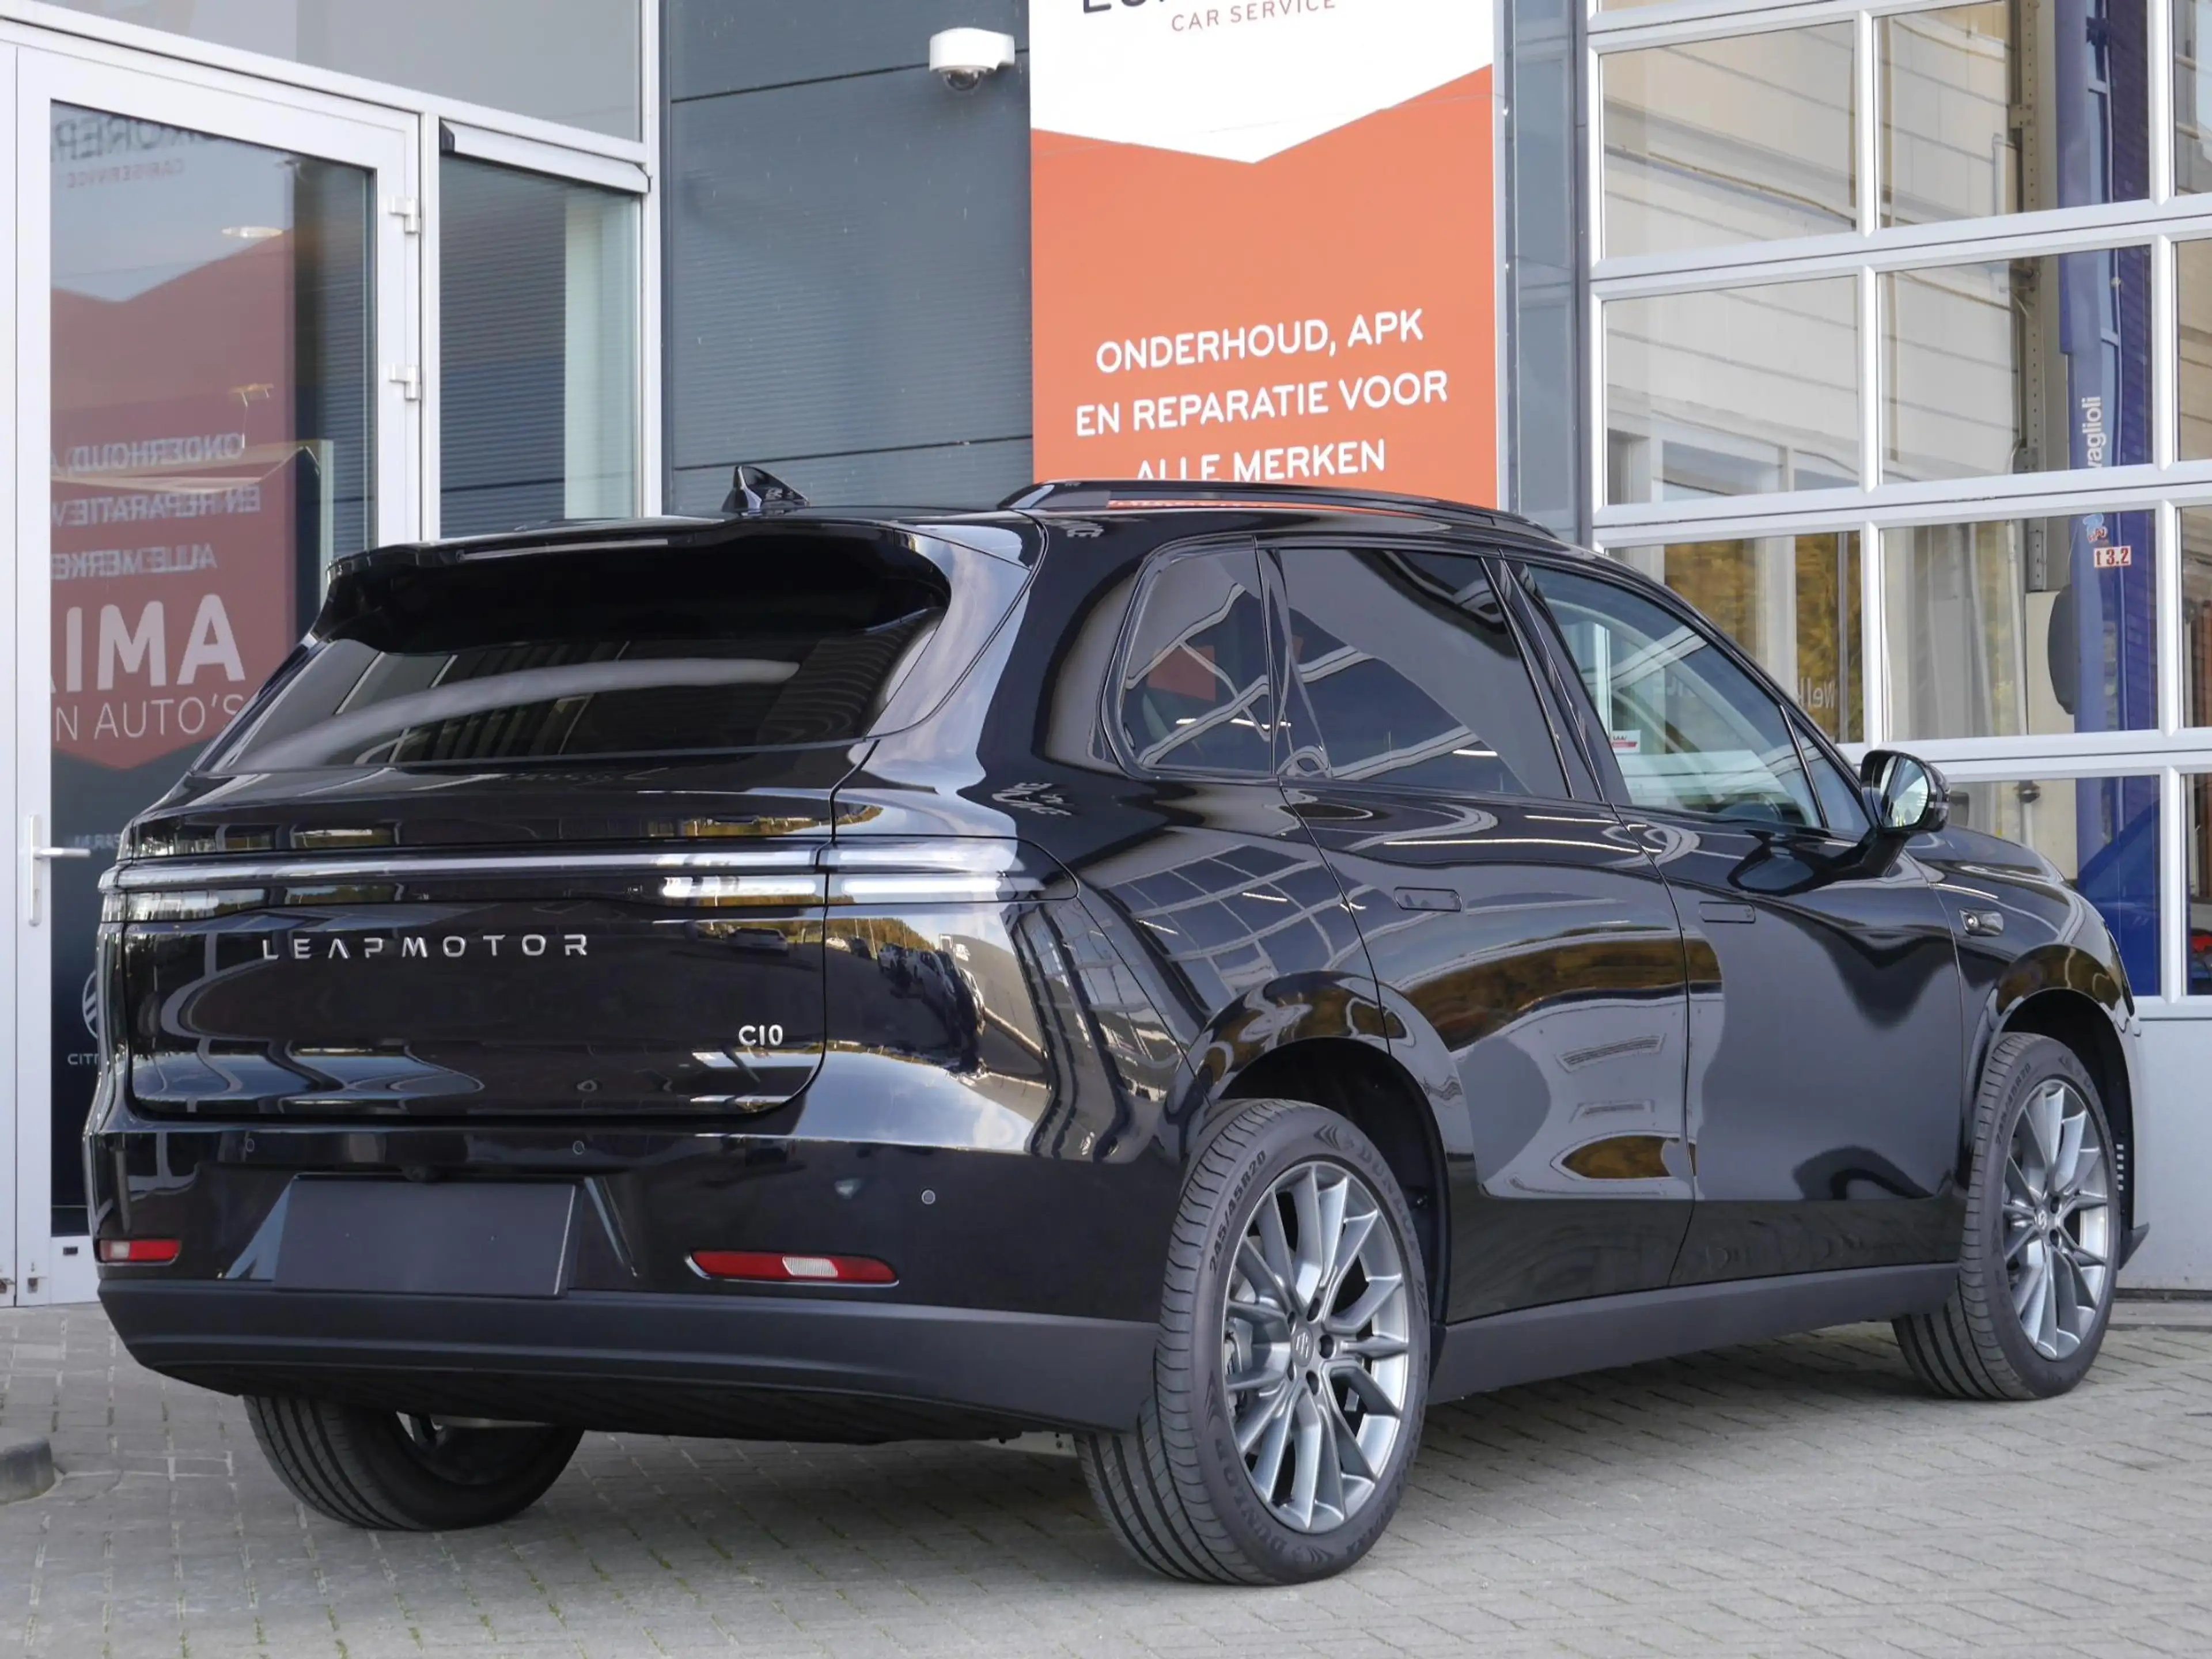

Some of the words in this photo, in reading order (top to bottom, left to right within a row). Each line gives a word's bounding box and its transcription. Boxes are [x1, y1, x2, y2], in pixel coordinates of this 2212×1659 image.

[1171, 9, 1219, 32] CAR
[1096, 319, 1336, 373] ONDERHOUD,
[1347, 308, 1424, 347] APK
[1076, 402, 1120, 436] EN
[1133, 381, 1329, 431] REPARATIE
[1338, 370, 1448, 410] VOOR
[1233, 438, 1385, 482] MERKEN
[2105, 547, 2130, 566] 3.2
[51, 593, 246, 694] IMA
[262, 933, 588, 960] LEAPMOTOR
[738, 1024, 783, 1047] C10
